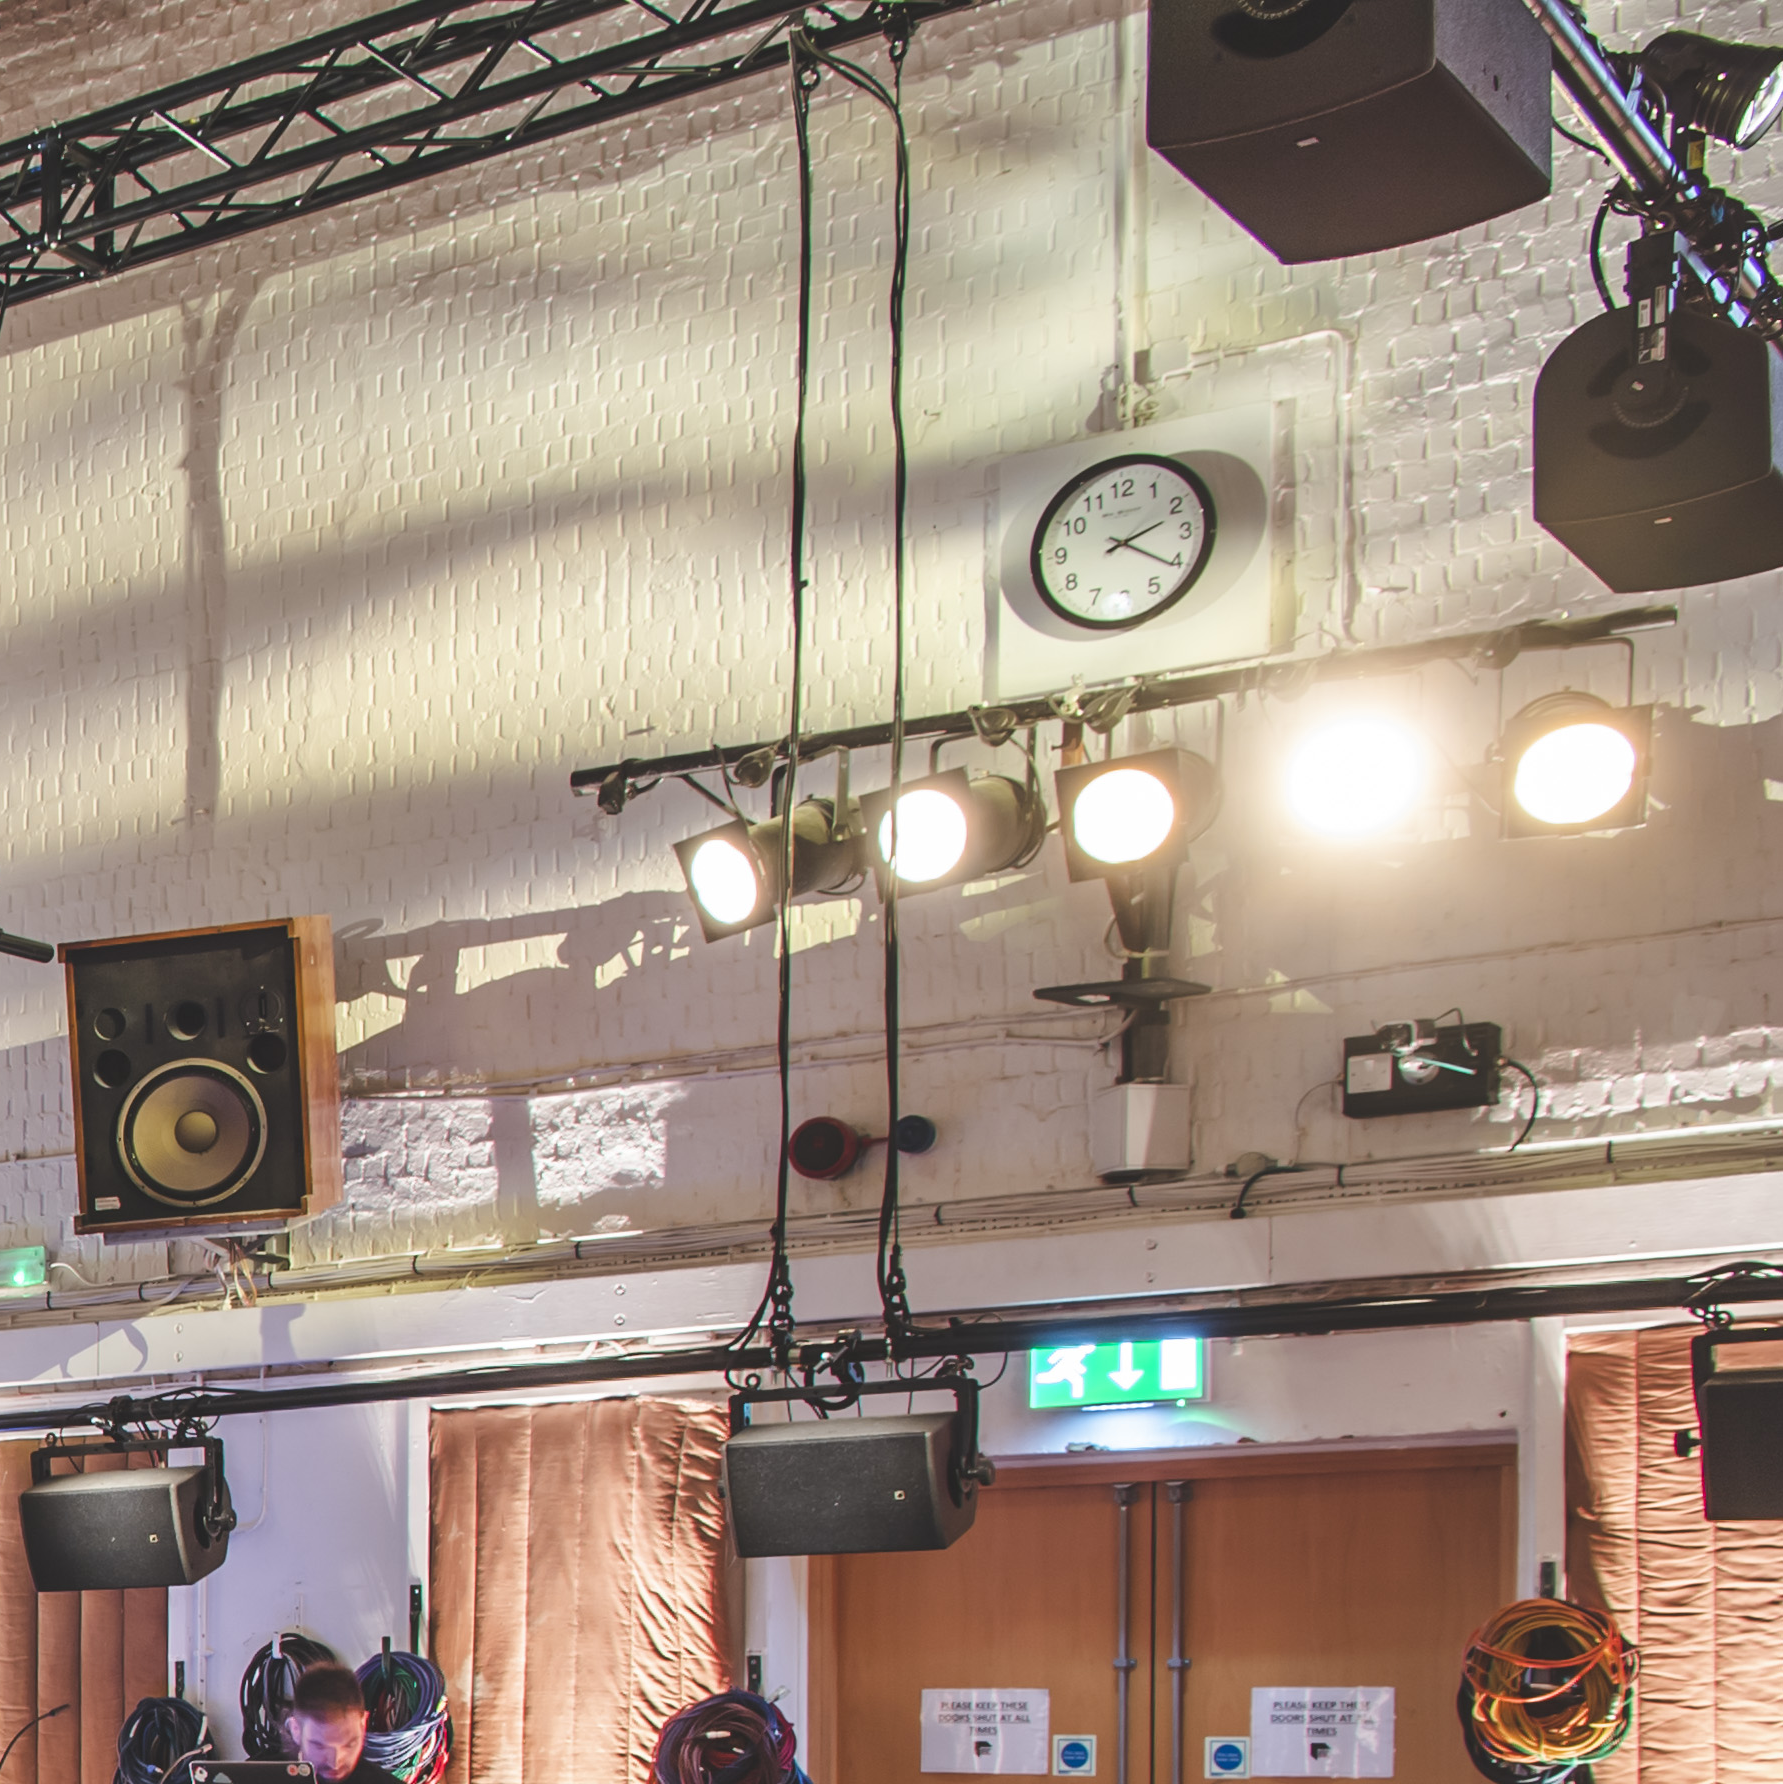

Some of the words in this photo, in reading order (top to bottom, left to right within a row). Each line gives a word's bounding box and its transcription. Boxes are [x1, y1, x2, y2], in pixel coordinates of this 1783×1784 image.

[1110, 479, 1134, 499] 12
[1149, 482, 1157, 499] 1
[1083, 494, 1103, 512] 11
[1169, 497, 1183, 515] 2
[1063, 517, 1086, 536] 10
[1179, 522, 1192, 539] 3
[1055, 547, 1067, 565] 9
[1171, 552, 1183, 569] 4
[1065, 573, 1078, 591] 8
[1147, 576, 1161, 594] 5
[1089, 587, 1102, 606] 7
[940, 1701, 973, 1711] PLEASE
[975, 1701, 998, 1711] KEEP
[1000, 1701, 1028, 1711] THESE
[1311, 1701, 1337, 1710] KEEP
[1000, 1714, 1012, 1723] AT
[1308, 1713, 1337, 1723] SHUT
[1339, 1713, 1353, 1723] AT
